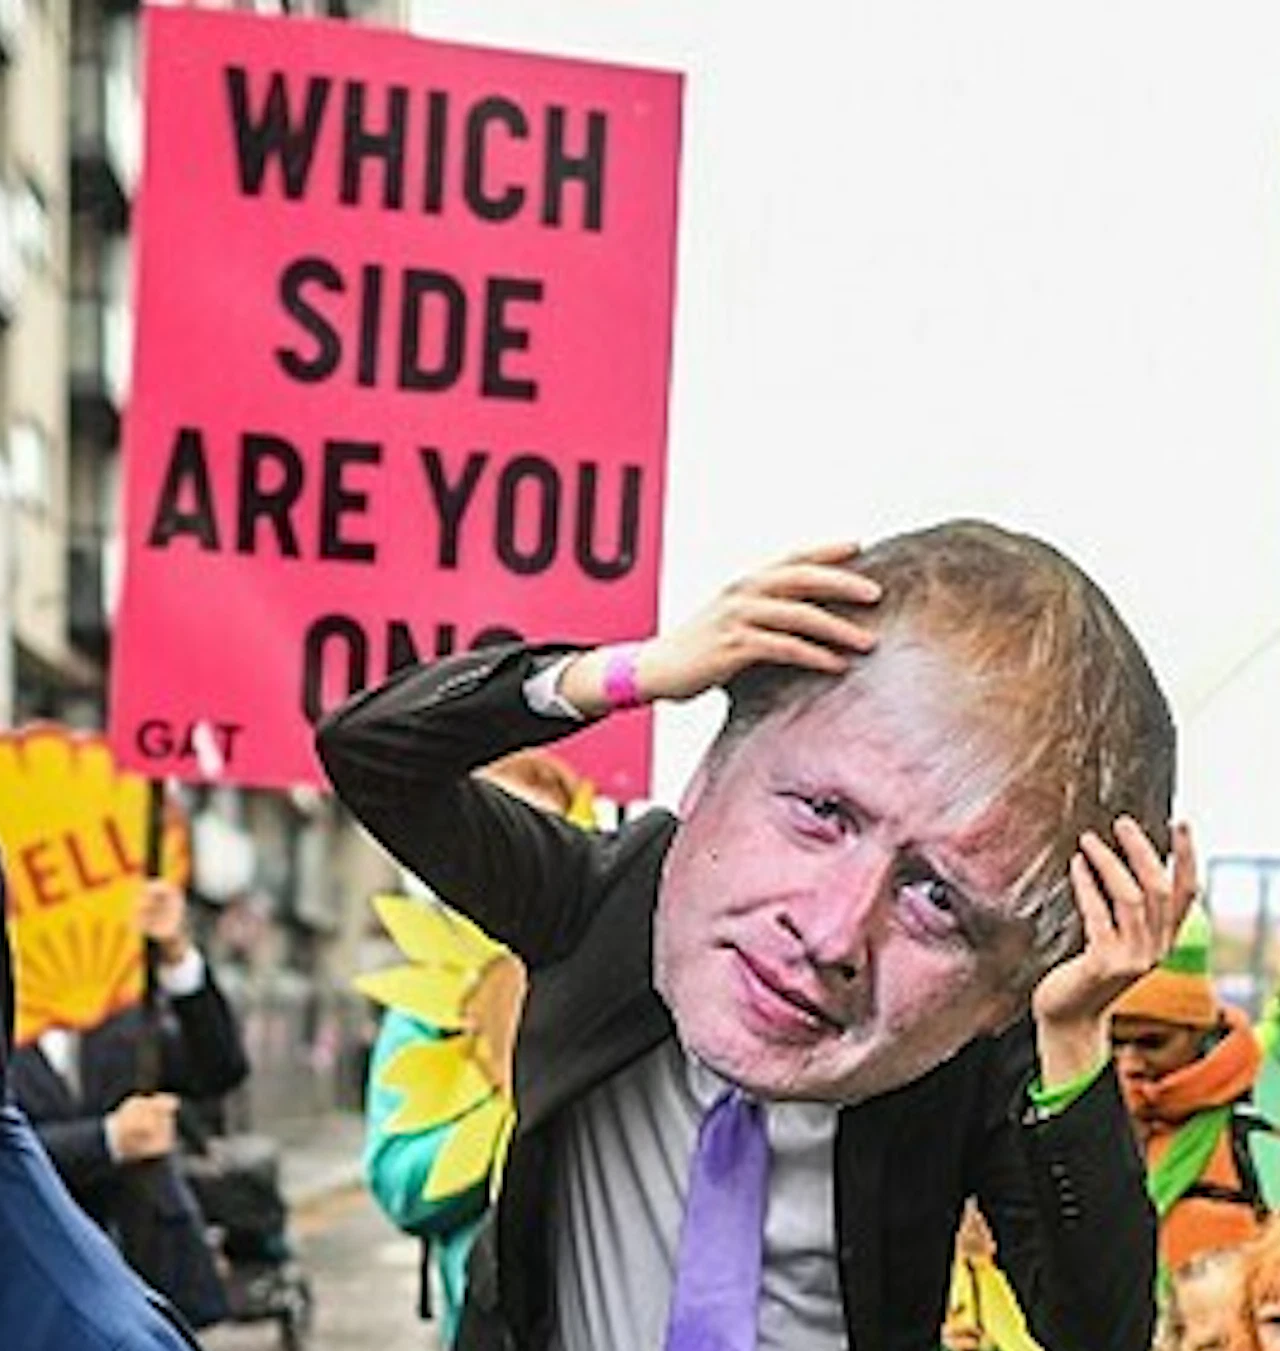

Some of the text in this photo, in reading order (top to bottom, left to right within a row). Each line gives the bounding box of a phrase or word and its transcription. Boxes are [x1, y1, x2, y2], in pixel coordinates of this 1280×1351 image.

[224, 64, 608, 232] WHICH
[273, 256, 544, 402] SIDE
[147, 427, 643, 583] ARE YOU
[9, 816, 145, 914] ELL
